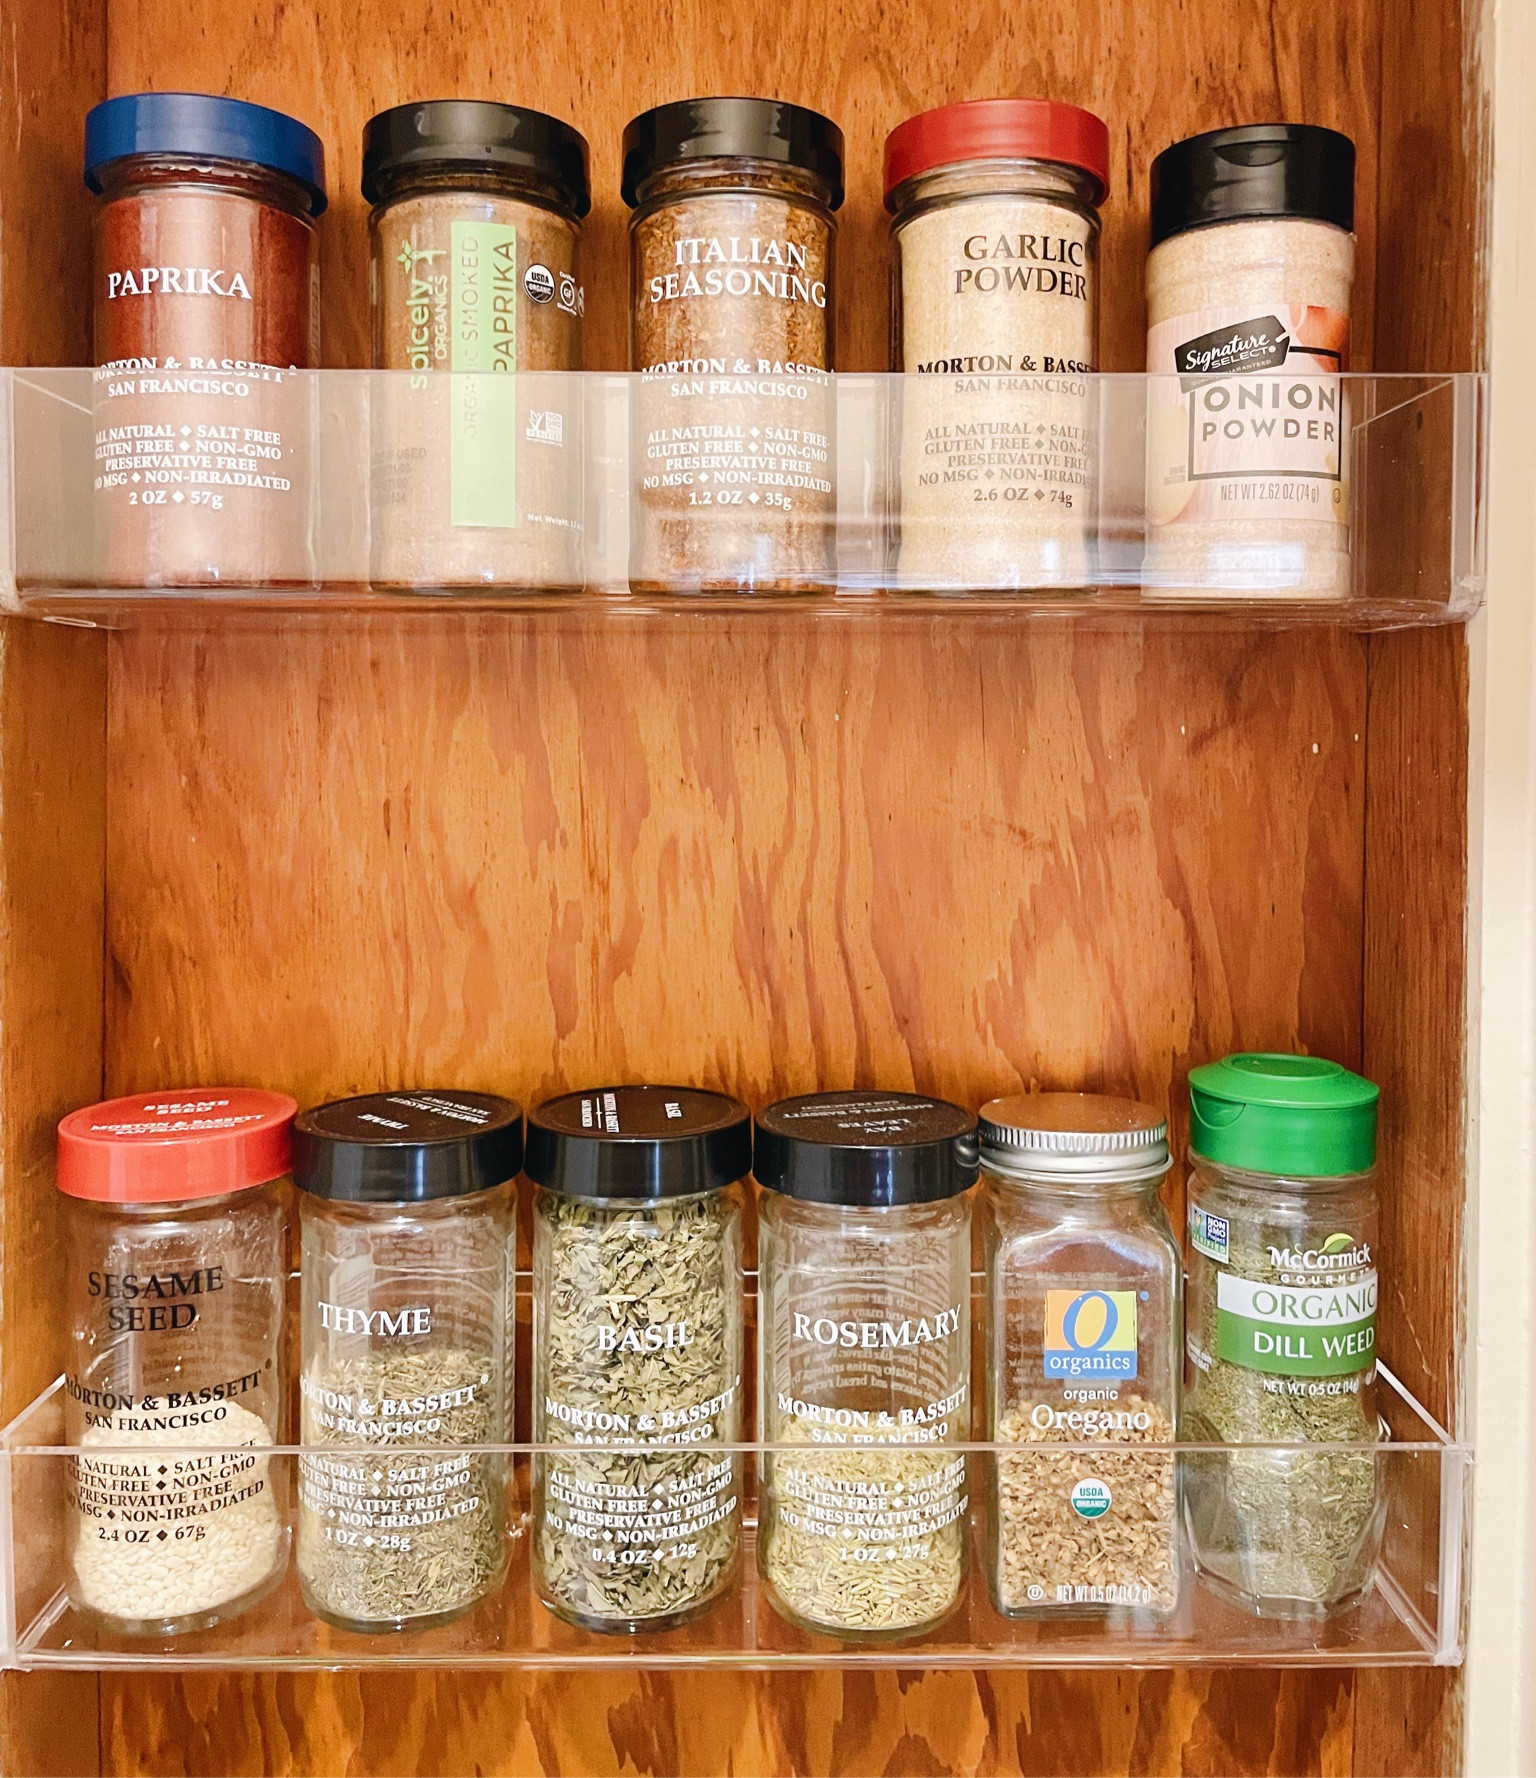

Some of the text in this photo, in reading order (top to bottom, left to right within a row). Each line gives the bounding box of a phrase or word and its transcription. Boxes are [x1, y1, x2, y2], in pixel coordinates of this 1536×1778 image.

[674, 237, 807, 270] ITALIAN
[964, 235, 1083, 267] GARLIC
[108, 268, 252, 300] PAPRIKA
[462, 237, 479, 341] SMOKED
[528, 283, 551, 294] ORGANIC
[532, 272, 549, 284] USDA
[651, 270, 826, 308] SEASONING
[954, 266, 1087, 300] POWDER
[435, 275, 447, 359] ORGANICS
[493, 242, 514, 371] PAPRIKA
[1185, 334, 1270, 371] Signature
[1212, 347, 1269, 369] SELECT
[109, 379, 248, 396] SAN FRANCISCO
[671, 381, 807, 399] SAN FRANCISCO
[954, 378, 1085, 397] SAN FRANCISCO
[1203, 383, 1335, 413] ONION
[109, 425, 281, 445] NATURAL SALT FREE
[648, 426, 800, 444] ALL NATURAL SALT
[925, 423, 1031, 440] ALL NATURAL
[1202, 418, 1334, 441] POWDER
[136, 440, 281, 459] FREE NON-GMO
[648, 441, 826, 462] GLUTEN FREE NON-GMO
[925, 438, 1029, 455] GLUTEN FREE
[105, 455, 257, 471] PRESERVATIVE FREE
[666, 456, 812, 473] PRESERVATIVE FREE
[947, 453, 1060, 468] PRESERVATIVE
[145, 471, 290, 490] NON-IRRADIATED
[643, 472, 831, 493] NO MSG NON-IRRADIATED
[919, 469, 978, 486] NO MSG
[142, 491, 223, 508] OZ 57g
[689, 491, 792, 510] 1.2 OZ 35g
[974, 488, 1072, 508] 2.6 OZ 74g
[1221, 485, 1238, 500] NET
[1242, 485, 1256, 500] WT
[528, 514, 542, 522] Net
[143, 1100, 229, 1111] SESAME
[157, 1107, 212, 1115] SEED
[838, 1118, 911, 1128] LEAVES
[865, 1126, 903, 1134] BAY
[1207, 1216, 1226, 1230] NON
[1207, 1226, 1226, 1239] GMO
[1267, 1243, 1371, 1269] McCormick
[88, 1266, 223, 1299] SESAME
[1252, 1283, 1376, 1319] ORGANIC
[109, 1303, 197, 1331] SEED
[318, 1301, 431, 1336] THYME
[793, 1304, 961, 1348] ROSEMARY
[597, 1321, 694, 1352] BASIL
[1254, 1327, 1374, 1358] DILL WEED
[1050, 1354, 1130, 1375] organics
[167, 1370, 261, 1408] BASSETT
[1064, 1387, 1118, 1402] organic
[1263, 1380, 1284, 1394] NET
[1288, 1383, 1305, 1395] WT
[382, 1384, 477, 1416] BASSETT
[545, 1387, 735, 1431] MORTON BASSETT
[778, 1385, 966, 1428] MORTON BASSETT
[86, 1407, 227, 1431] SAN FRANCISCO
[338, 1418, 441, 1436] FRANCISCO
[1032, 1404, 1150, 1435] Oregano
[84, 1457, 213, 1477] NATURAL SALT
[112, 1456, 255, 1492] FREE NON-GMO
[388, 1455, 470, 1482] SALT FREE
[551, 1456, 731, 1498] ALL NATURAL SALT FREE
[80, 1481, 233, 1507] PRESERVATIVE FREE
[332, 1470, 470, 1497] FREE NON-GMO
[551, 1472, 732, 1512] GLUTEN FREE NON-GMO
[785, 1471, 965, 1510] GLUTEN FREE NON-GMO
[811, 1473, 889, 1495] NATURAL
[1080, 1488, 1103, 1496] USDA
[121, 1480, 264, 1522] NON-IRRADIATED
[340, 1496, 479, 1527] NON-IRRADIATED
[406, 1493, 445, 1510] FREE
[1076, 1500, 1106, 1508] ORGANIC
[547, 1496, 737, 1543] NO MSG NON-IRRADIATED
[569, 1497, 716, 1528] PRESERVATIVE FREE
[780, 1509, 836, 1538] NO MSG
[806, 1504, 920, 1526] PRESERVATIVE
[99, 1525, 206, 1543] 2.4 OZ 67g
[325, 1527, 411, 1551] 1 OZ 28g
[592, 1543, 697, 1564] 0.4 OZ 12g
[840, 1544, 929, 1562] 1 OZ 27g
[1057, 1586, 1072, 1601] NET
[1075, 1586, 1088, 1601] WT
[1091, 1586, 1103, 1600] 0.5
